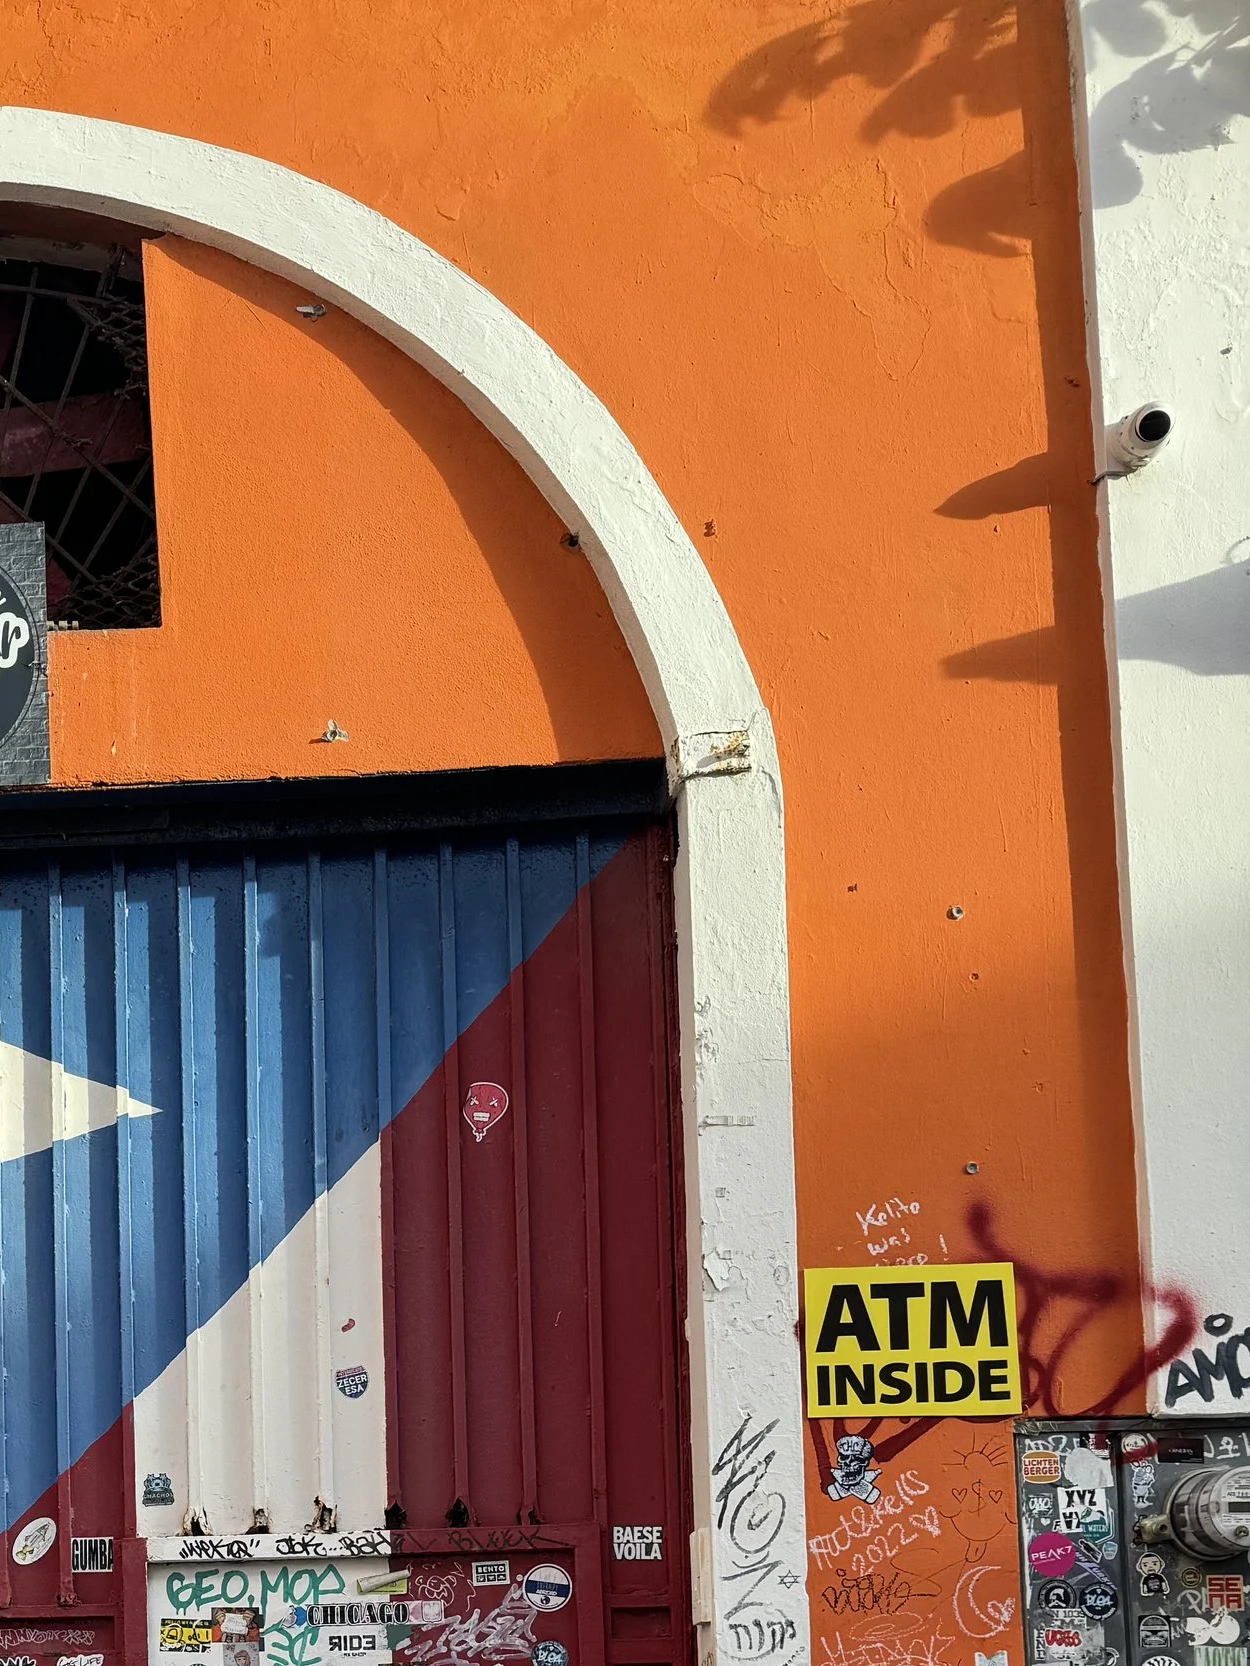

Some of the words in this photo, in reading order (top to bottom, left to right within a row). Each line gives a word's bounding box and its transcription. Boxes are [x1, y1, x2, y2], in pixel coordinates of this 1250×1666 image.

[815, 1280, 1010, 1353] ATM
[816, 1360, 1012, 1407] INSIDE
[1023, 1458, 1059, 1467] LICHTEN
[1023, 1466, 1060, 1476] BERGER
[613, 1526, 662, 1543] BAESE
[614, 1543, 662, 1560] VOILA
[477, 1564, 505, 1573] BENTO
[306, 1604, 410, 1627] CHICAGO
